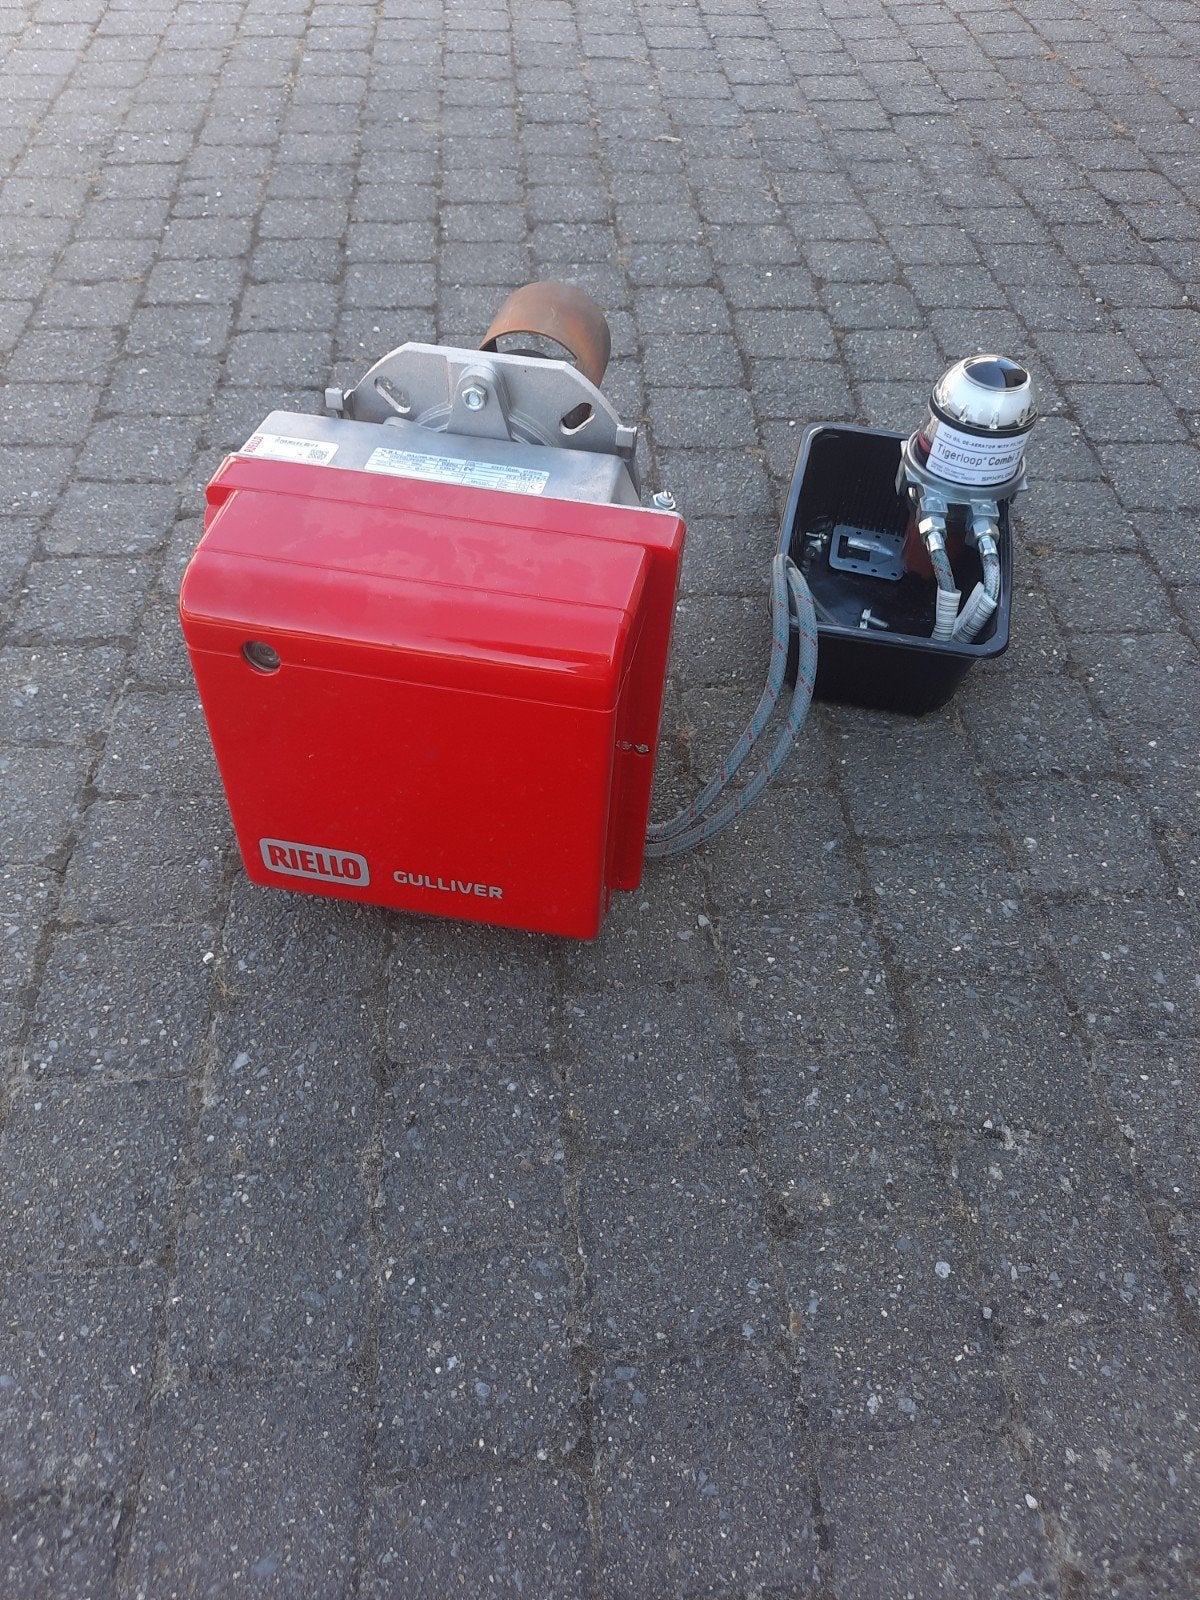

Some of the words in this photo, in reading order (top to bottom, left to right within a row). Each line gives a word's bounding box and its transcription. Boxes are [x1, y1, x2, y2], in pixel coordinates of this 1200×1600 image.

[988, 453, 1014, 466] Combi
[267, 844, 361, 880] RIELLO
[393, 870, 503, 899] GULLIVER
